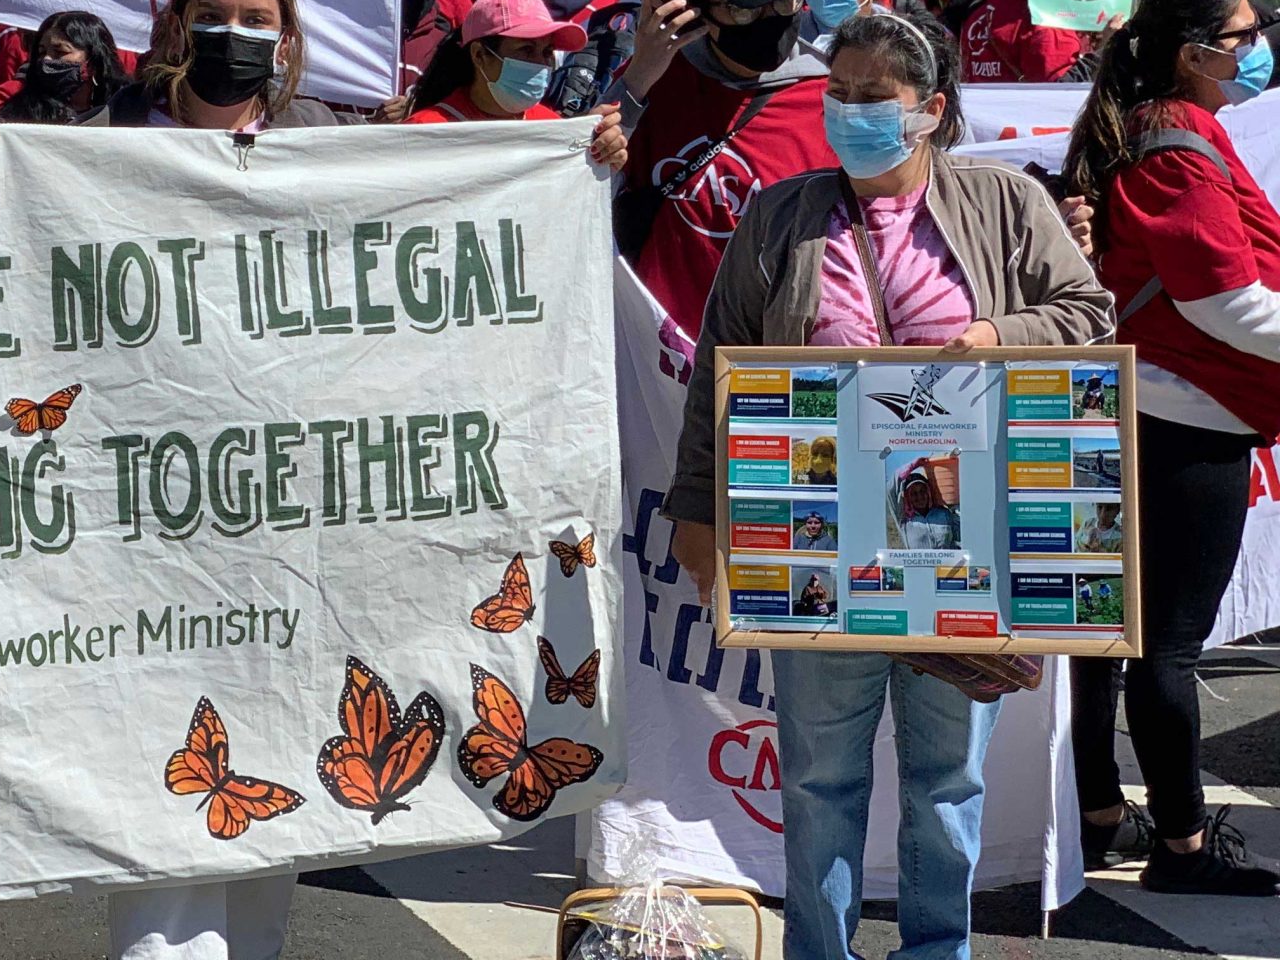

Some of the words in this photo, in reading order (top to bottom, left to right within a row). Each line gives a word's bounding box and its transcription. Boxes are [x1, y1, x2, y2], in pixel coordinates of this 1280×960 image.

[689, 140, 727, 172] adidas
[50, 237, 205, 351] NOT
[234, 218, 544, 340] ILLEGAL
[917, 423, 977, 431] FARMWORKER
[101, 410, 508, 542] TOGETHER
[136, 600, 301, 650] Ministry
[709, 729, 782, 790] CA
